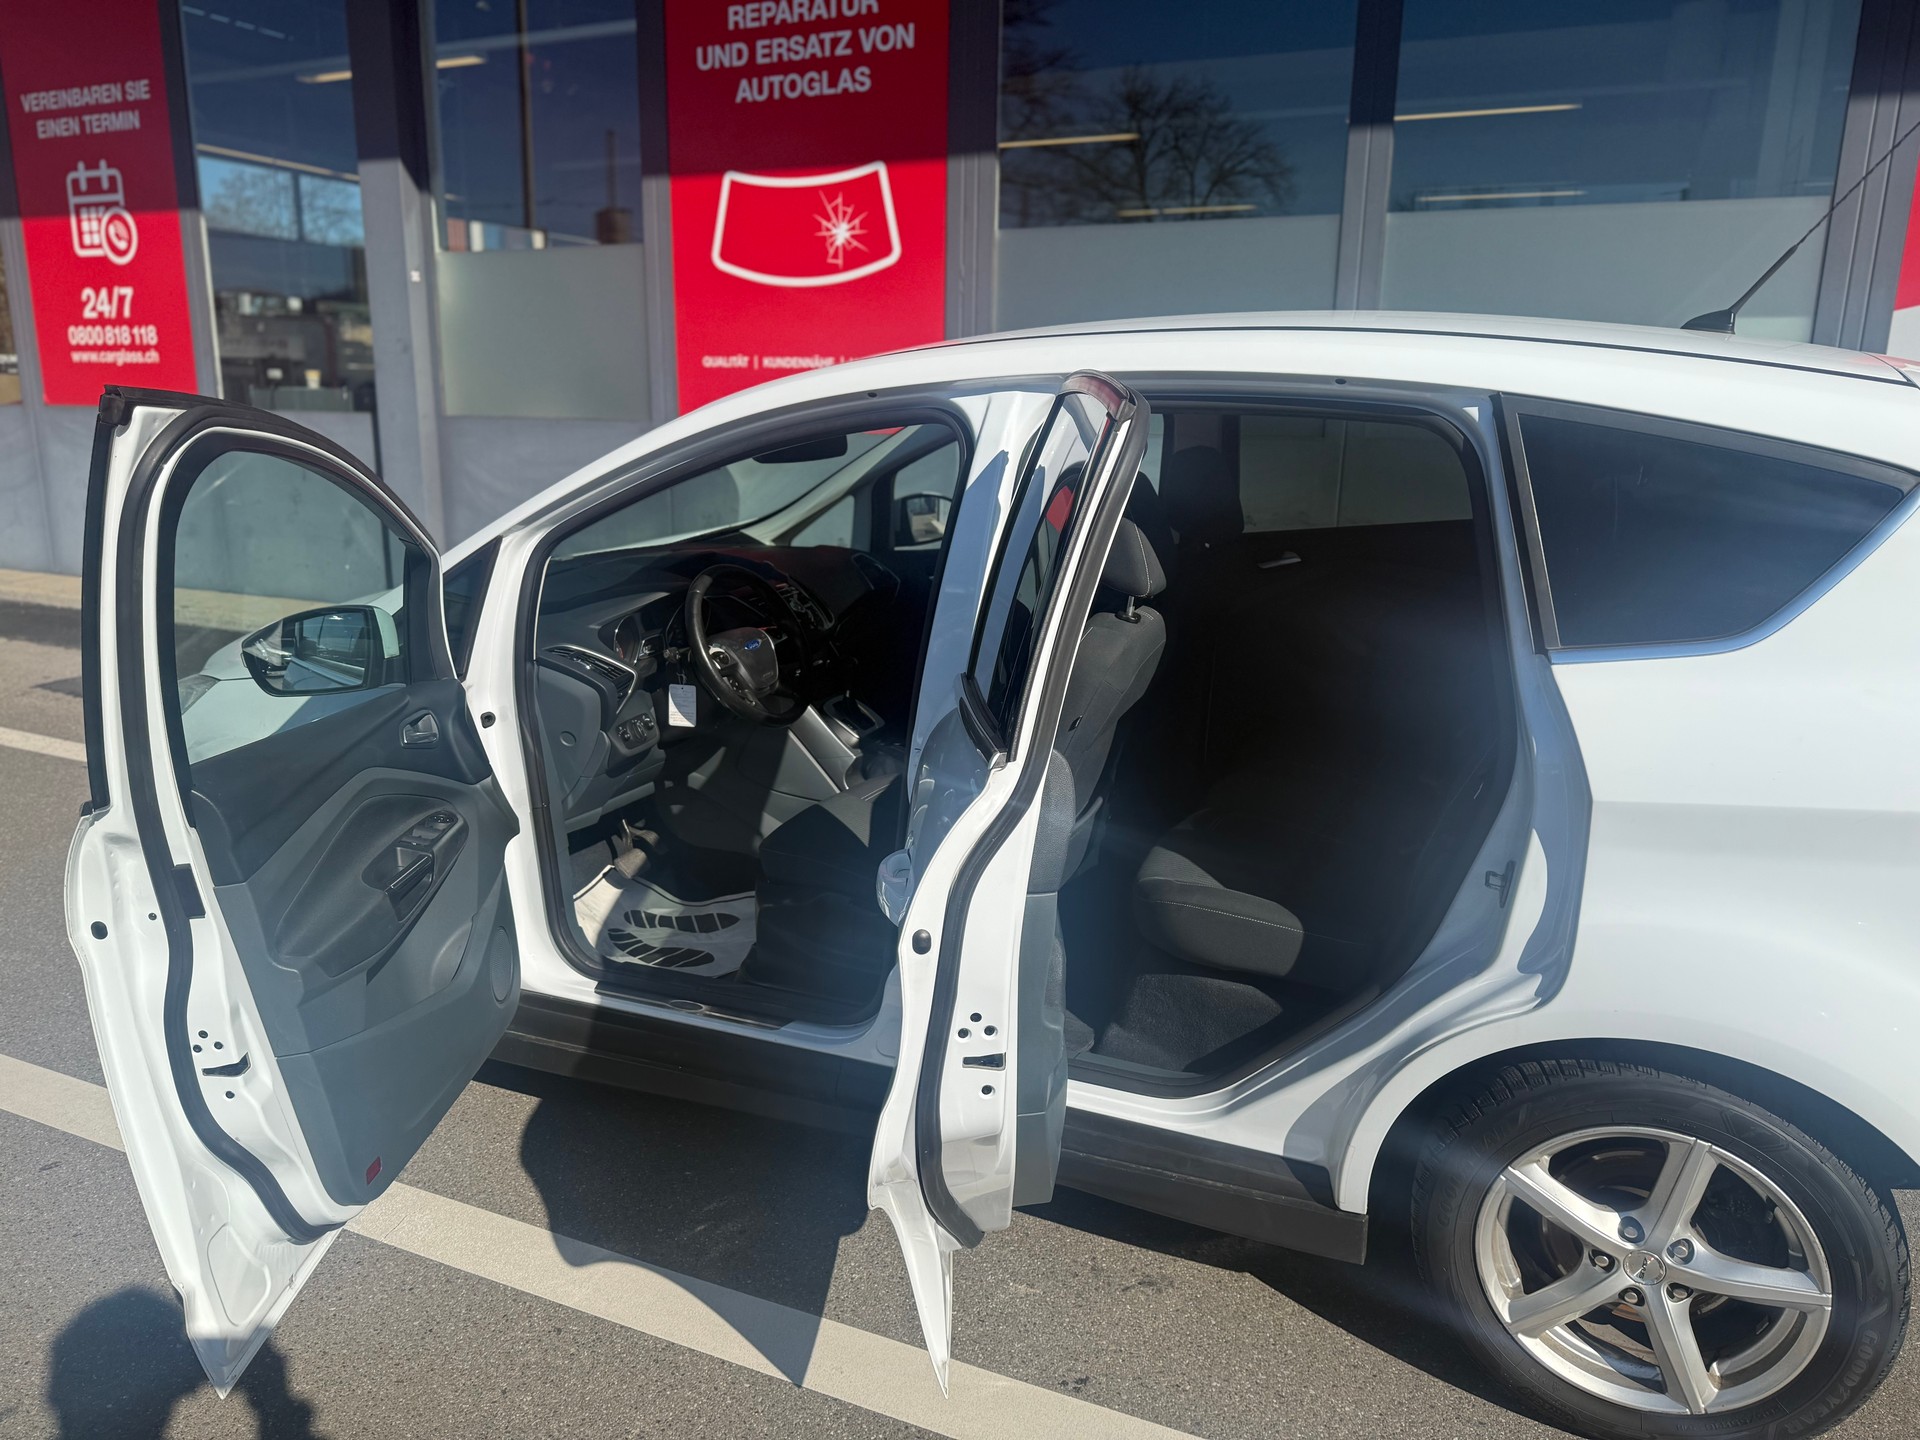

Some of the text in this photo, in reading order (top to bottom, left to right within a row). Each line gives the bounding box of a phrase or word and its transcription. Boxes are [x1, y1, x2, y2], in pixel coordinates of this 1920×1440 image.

[727, 0, 879, 31] REPARATUR
[695, 22, 915, 71] UND ERSATZ VON
[20, 79, 151, 113] VEREINBAREN SIE
[734, 66, 872, 103] AUTOGLAS
[36, 110, 141, 139] EINEN TERMIN
[81, 285, 134, 319] 24/7
[70, 348, 160, 367] www.carglass.ch
[702, 354, 749, 368] QUALITÄT
